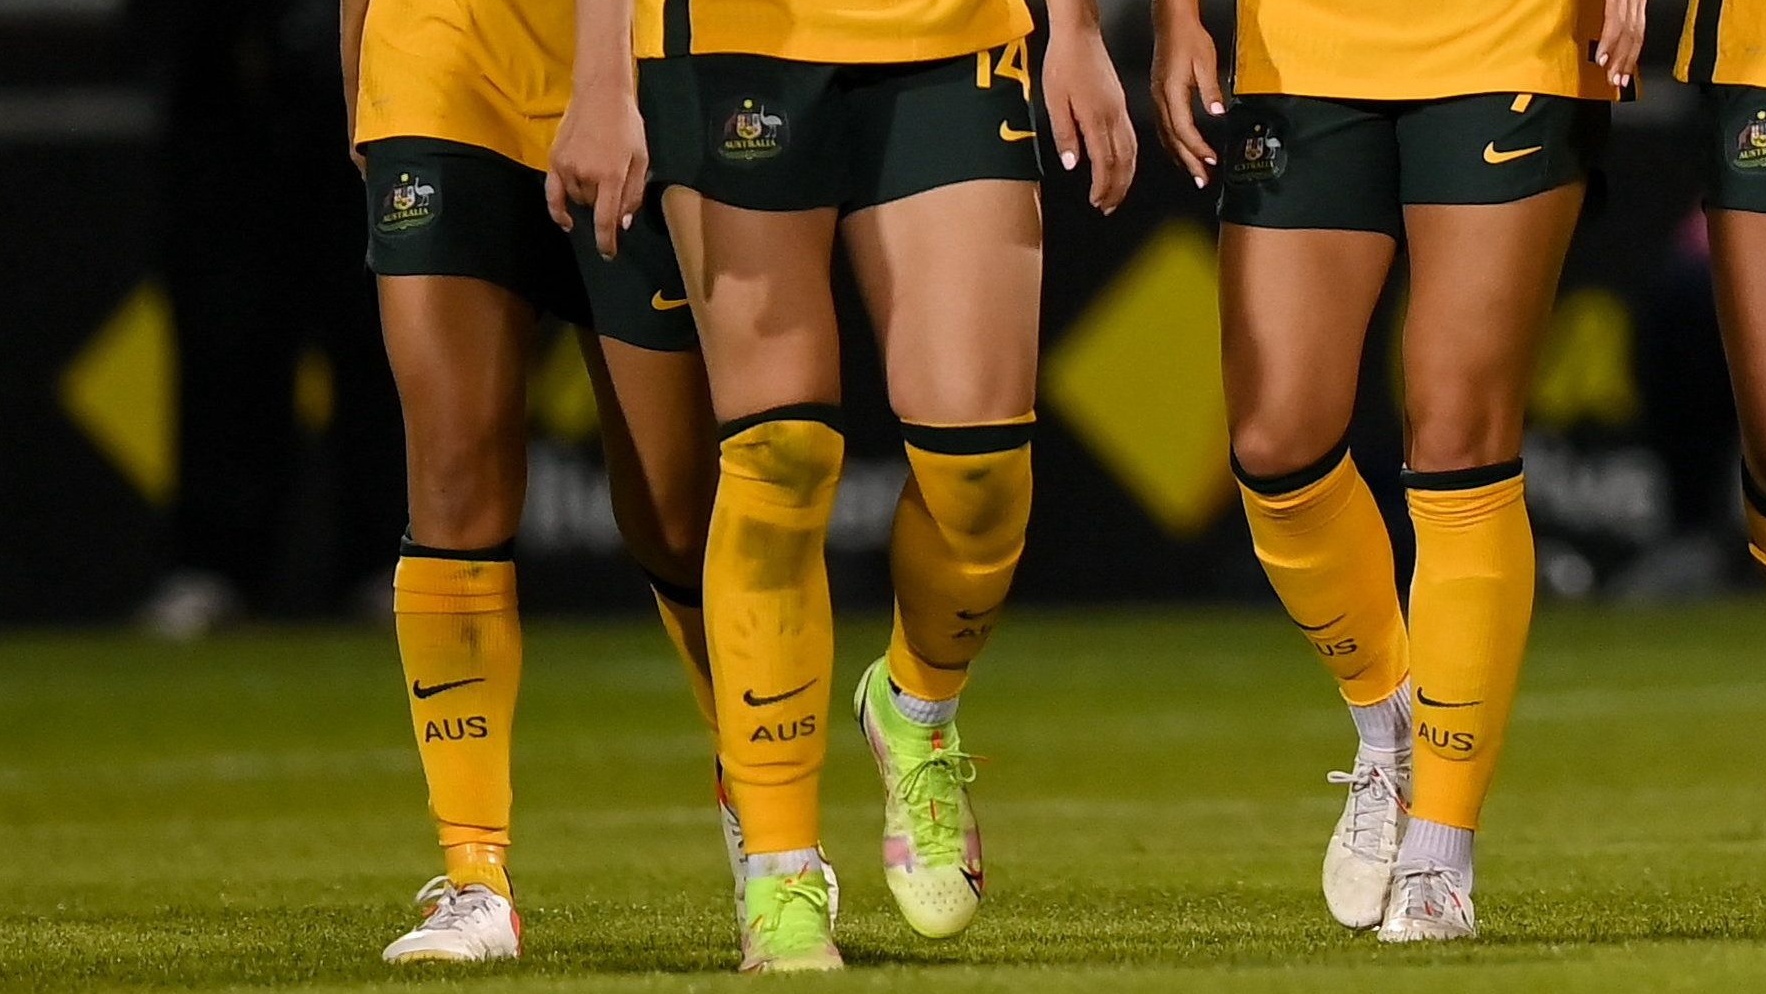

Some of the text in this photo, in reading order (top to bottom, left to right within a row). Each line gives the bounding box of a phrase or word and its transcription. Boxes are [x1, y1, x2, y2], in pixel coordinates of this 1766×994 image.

[1314, 637, 1358, 657] US
[424, 716, 489, 743] AUS
[749, 715, 817, 743] AUS
[1417, 721, 1475, 753] AUS
